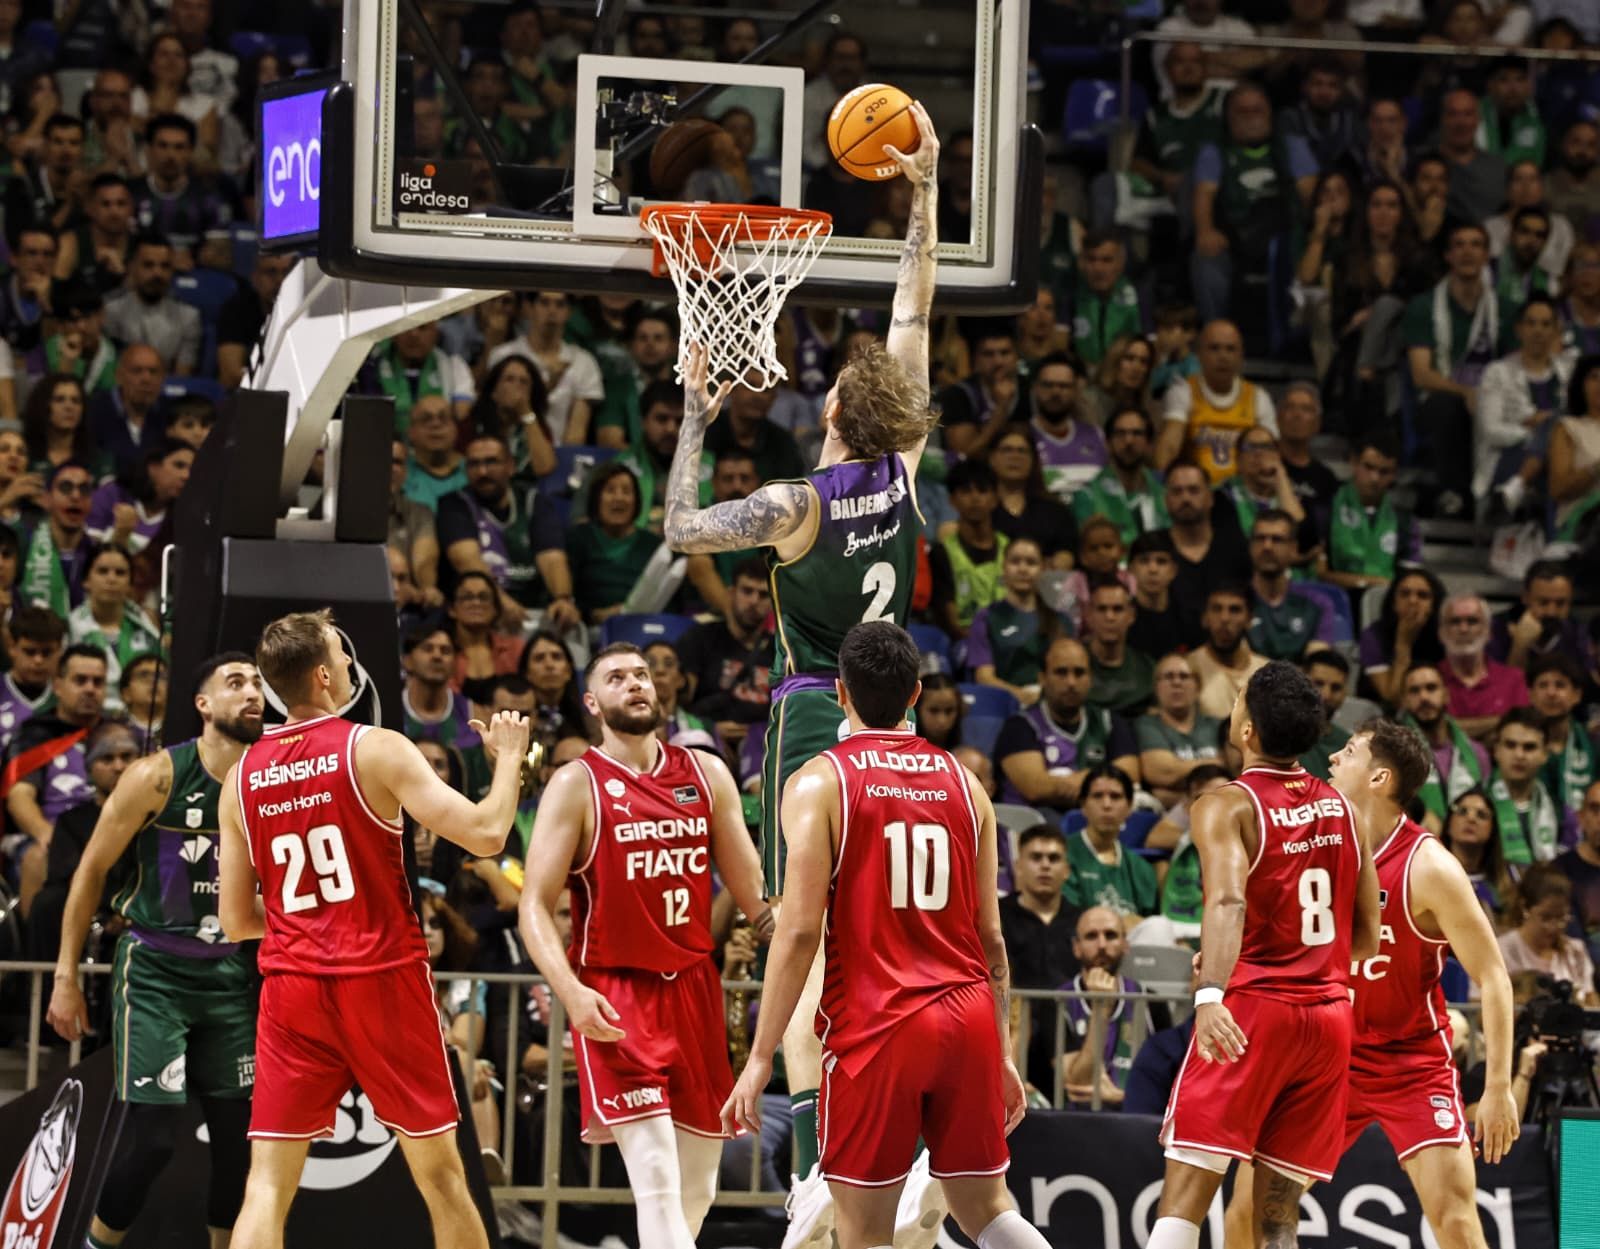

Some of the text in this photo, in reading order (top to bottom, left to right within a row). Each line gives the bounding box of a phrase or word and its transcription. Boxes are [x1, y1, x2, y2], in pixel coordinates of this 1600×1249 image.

[400, 172, 432, 192] liga
[400, 191, 469, 209] endesa
[862, 561, 896, 624] 2
[249, 753, 338, 791] SUŠINSKAS
[848, 750, 950, 773] VILDOZA
[258, 790, 332, 818] Kave Home
[865, 784, 948, 801] Kave Home
[1269, 798, 1344, 828] HUGHES
[614, 816, 708, 843] GIRONA
[1282, 840, 1310, 855] Kave
[271, 823, 355, 915] 29
[626, 846, 708, 881] FIATC
[883, 821, 950, 911] 10
[662, 887, 690, 927] 12
[1298, 867, 1336, 946] 8
